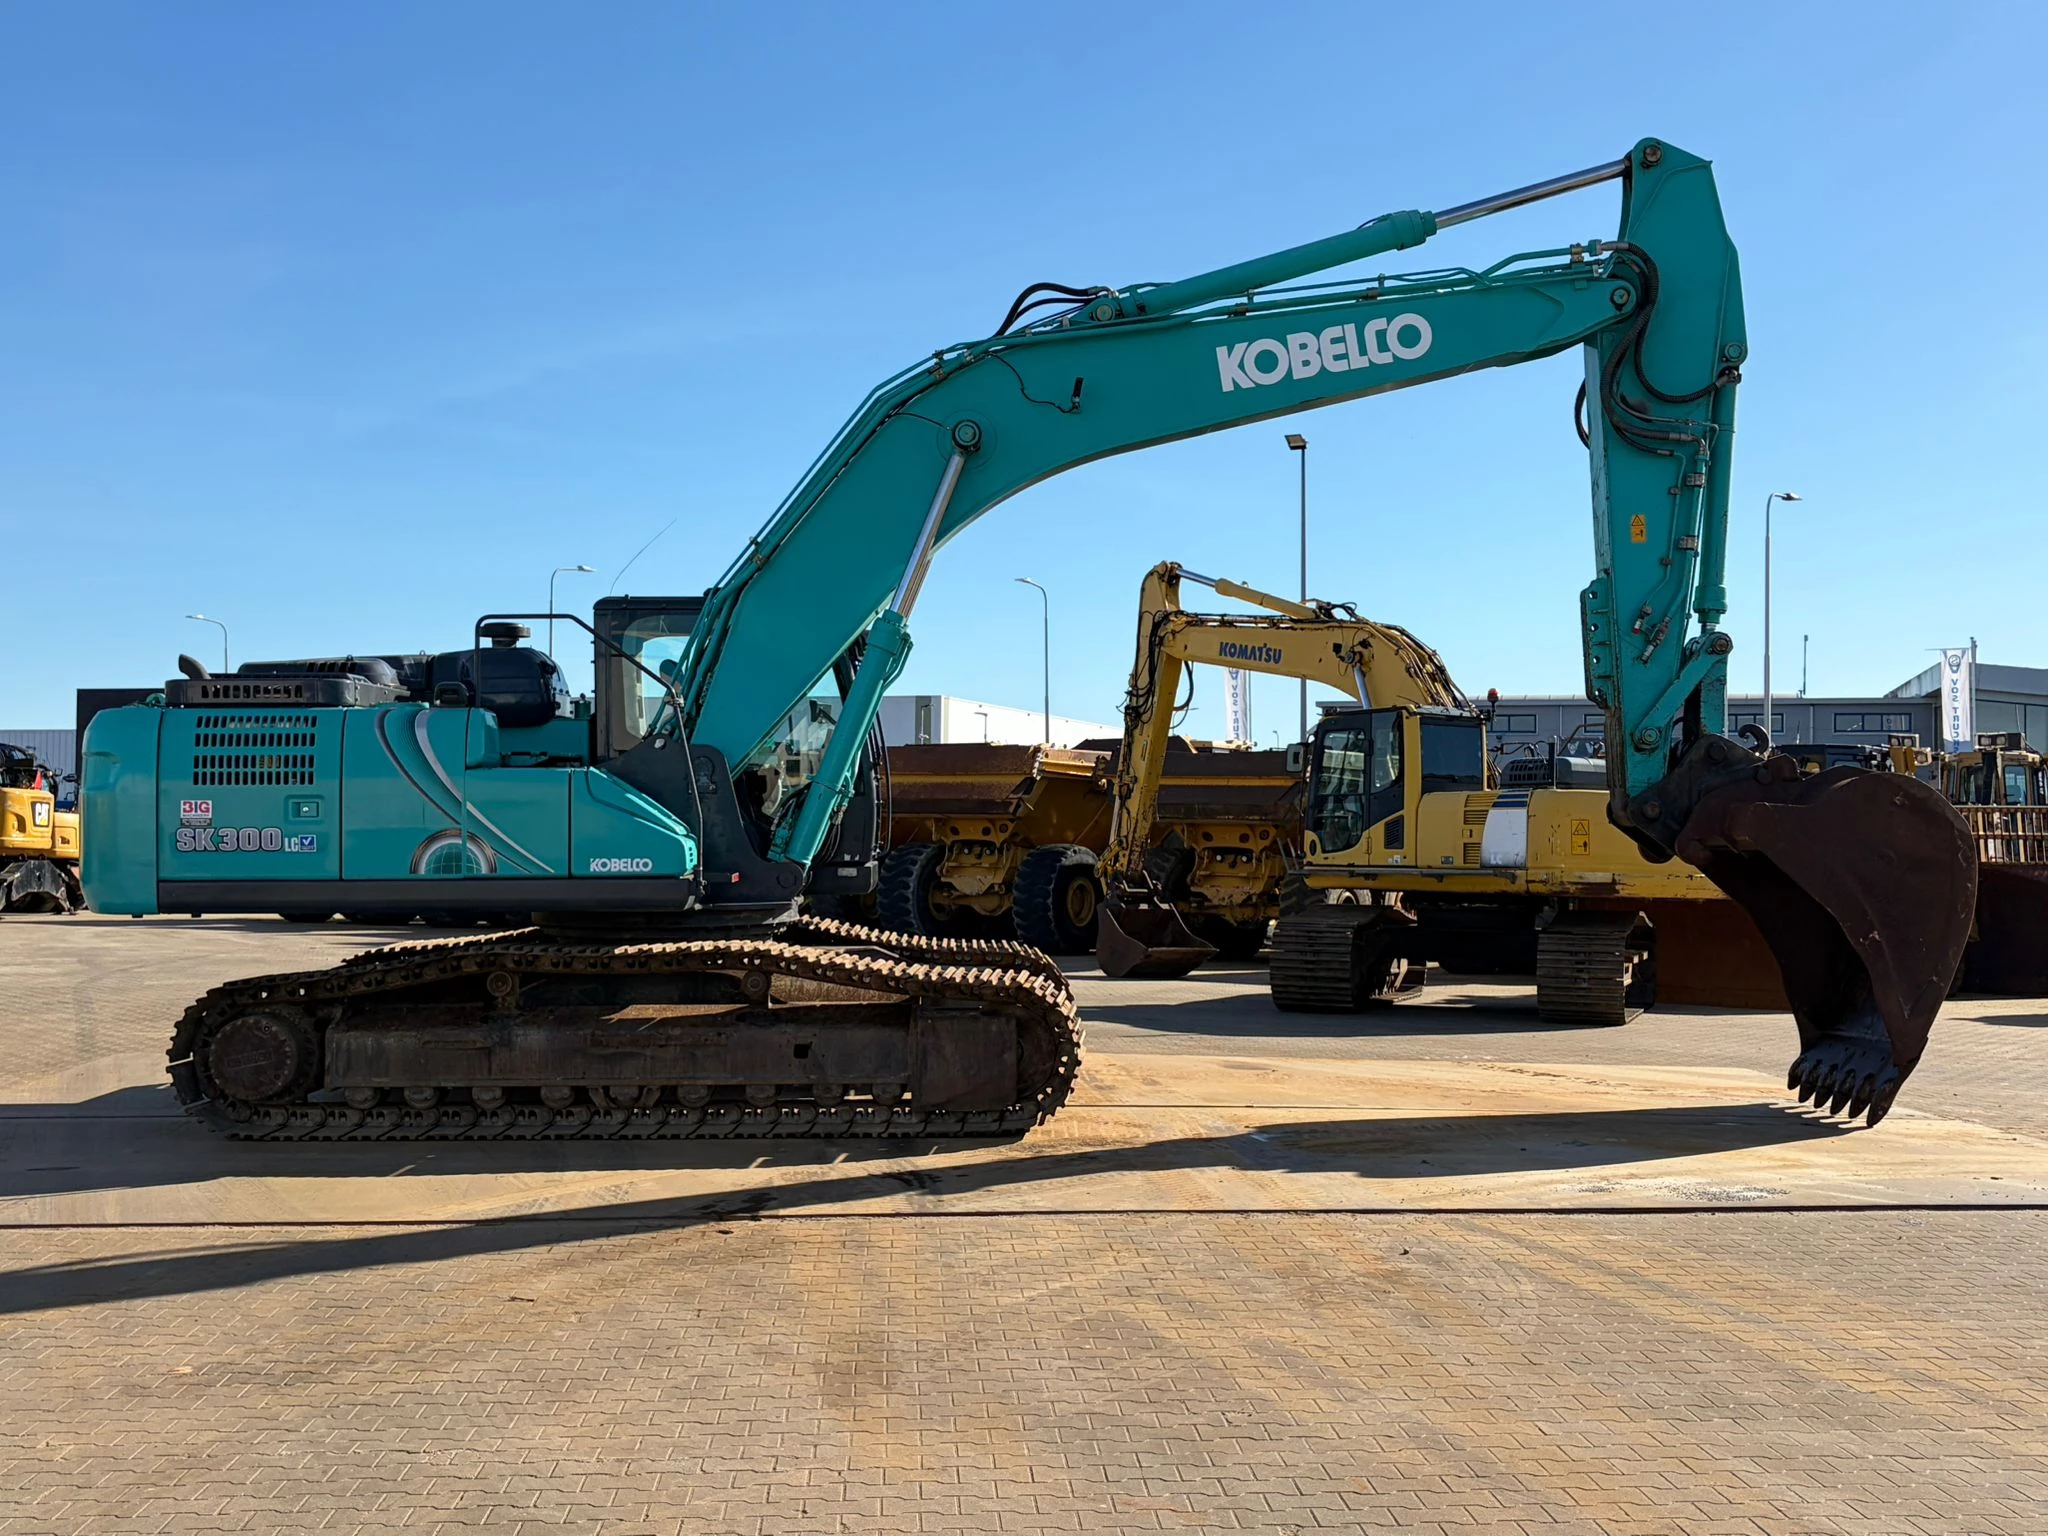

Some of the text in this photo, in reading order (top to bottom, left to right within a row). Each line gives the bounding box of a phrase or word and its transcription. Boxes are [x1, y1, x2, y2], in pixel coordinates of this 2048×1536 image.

[1216, 312, 1433, 393] KOBELCO
[1219, 641, 1283, 665] KOMATSU
[35, 802, 50, 826] CAT
[182, 801, 212, 814] BIG
[284, 837, 299, 853] LC
[589, 857, 653, 873] KOBELCO
